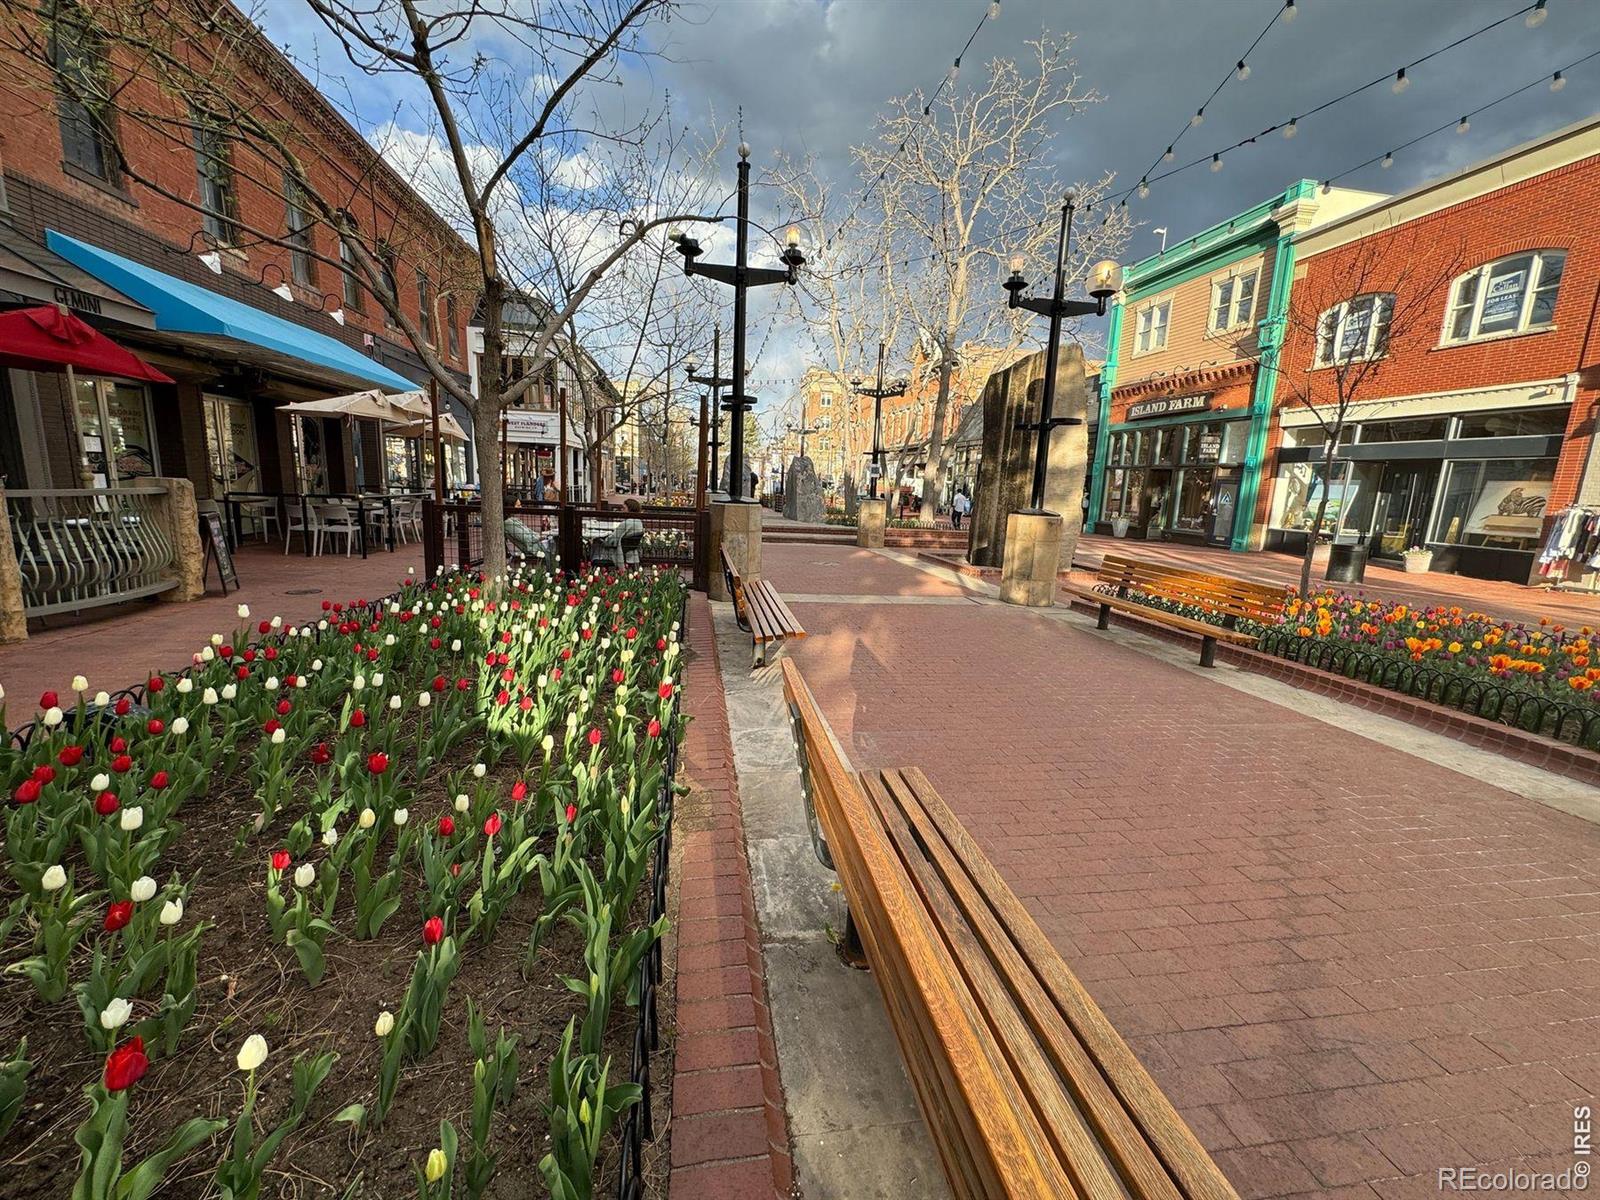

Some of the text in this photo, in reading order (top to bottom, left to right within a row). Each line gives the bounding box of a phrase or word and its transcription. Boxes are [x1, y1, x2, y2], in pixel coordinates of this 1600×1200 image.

[54, 288, 102, 315] GEMINI
[1131, 396, 1205, 416] ISLAND FARM
